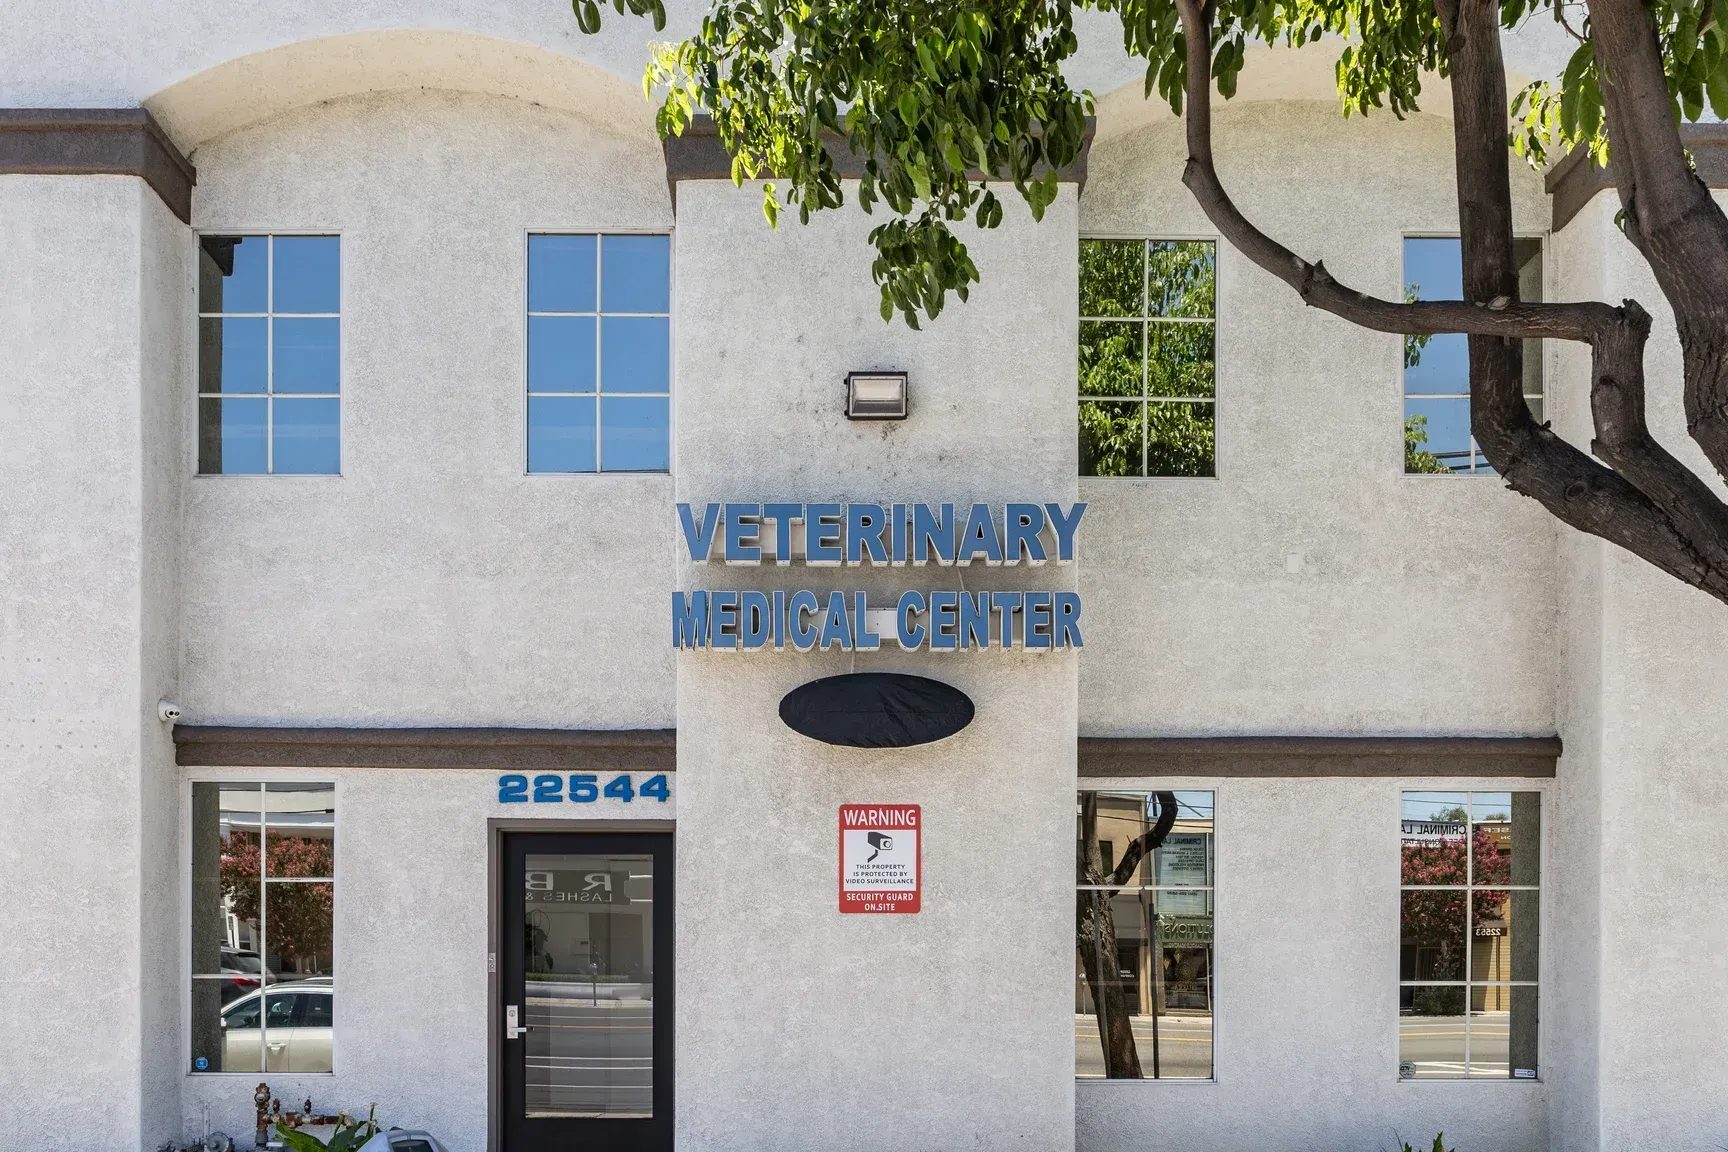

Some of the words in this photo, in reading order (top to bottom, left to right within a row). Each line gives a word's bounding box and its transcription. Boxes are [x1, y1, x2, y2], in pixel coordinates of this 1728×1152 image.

[676, 503, 1088, 565] VETERINARY
[671, 590, 880, 651] MEDICAL
[897, 590, 1084, 651] CENTER
[498, 774, 670, 803] 22544
[843, 809, 916, 826] WARNING
[846, 893, 884, 901] SECURITY
[886, 893, 914, 901] GUARD
